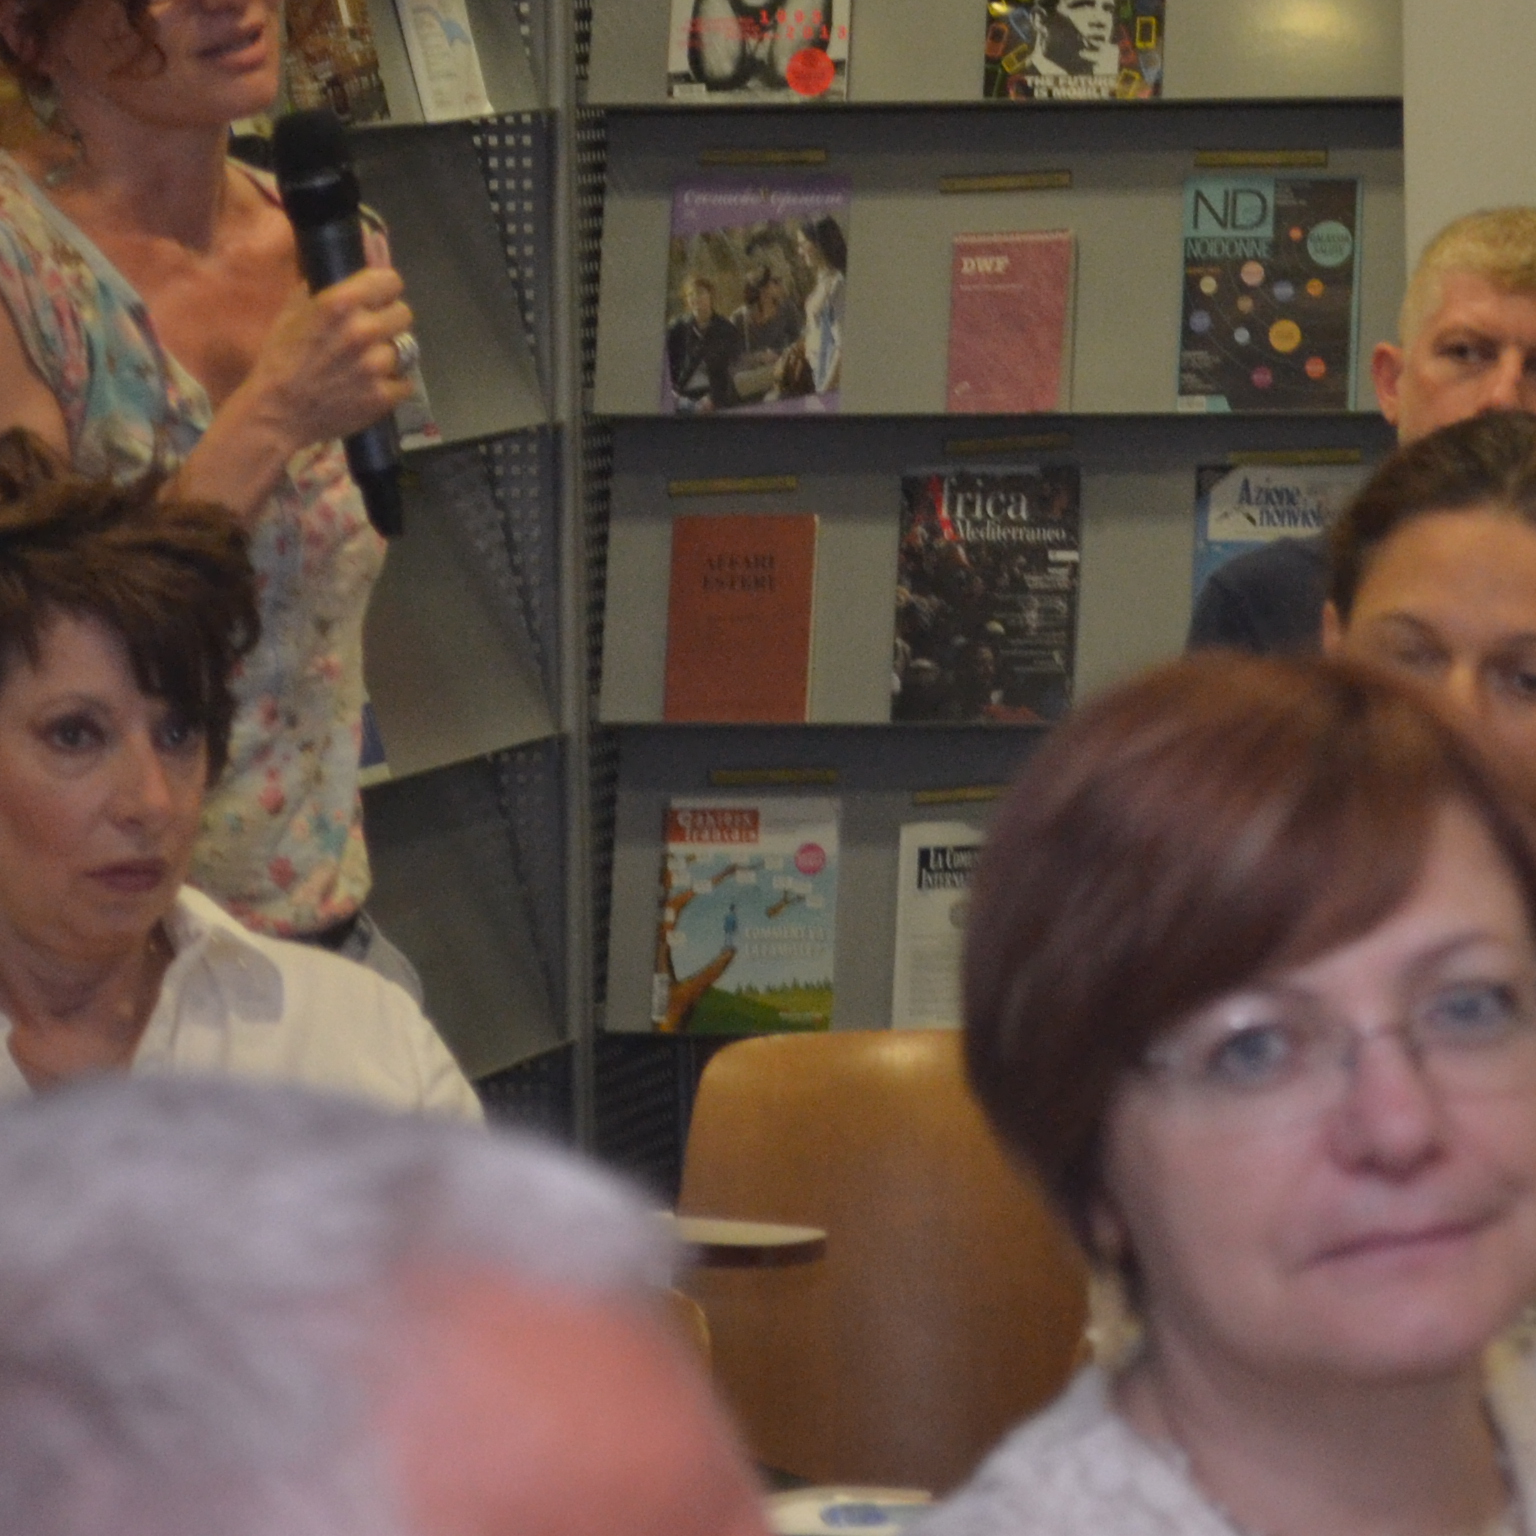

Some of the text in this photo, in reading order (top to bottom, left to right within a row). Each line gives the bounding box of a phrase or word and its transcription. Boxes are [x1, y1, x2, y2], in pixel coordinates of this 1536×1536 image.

[1193, 188, 1269, 231] ND
[961, 255, 1010, 275] DWF
[1238, 476, 1301, 507] Azione
[955, 519, 1067, 543] Mediterraneo
